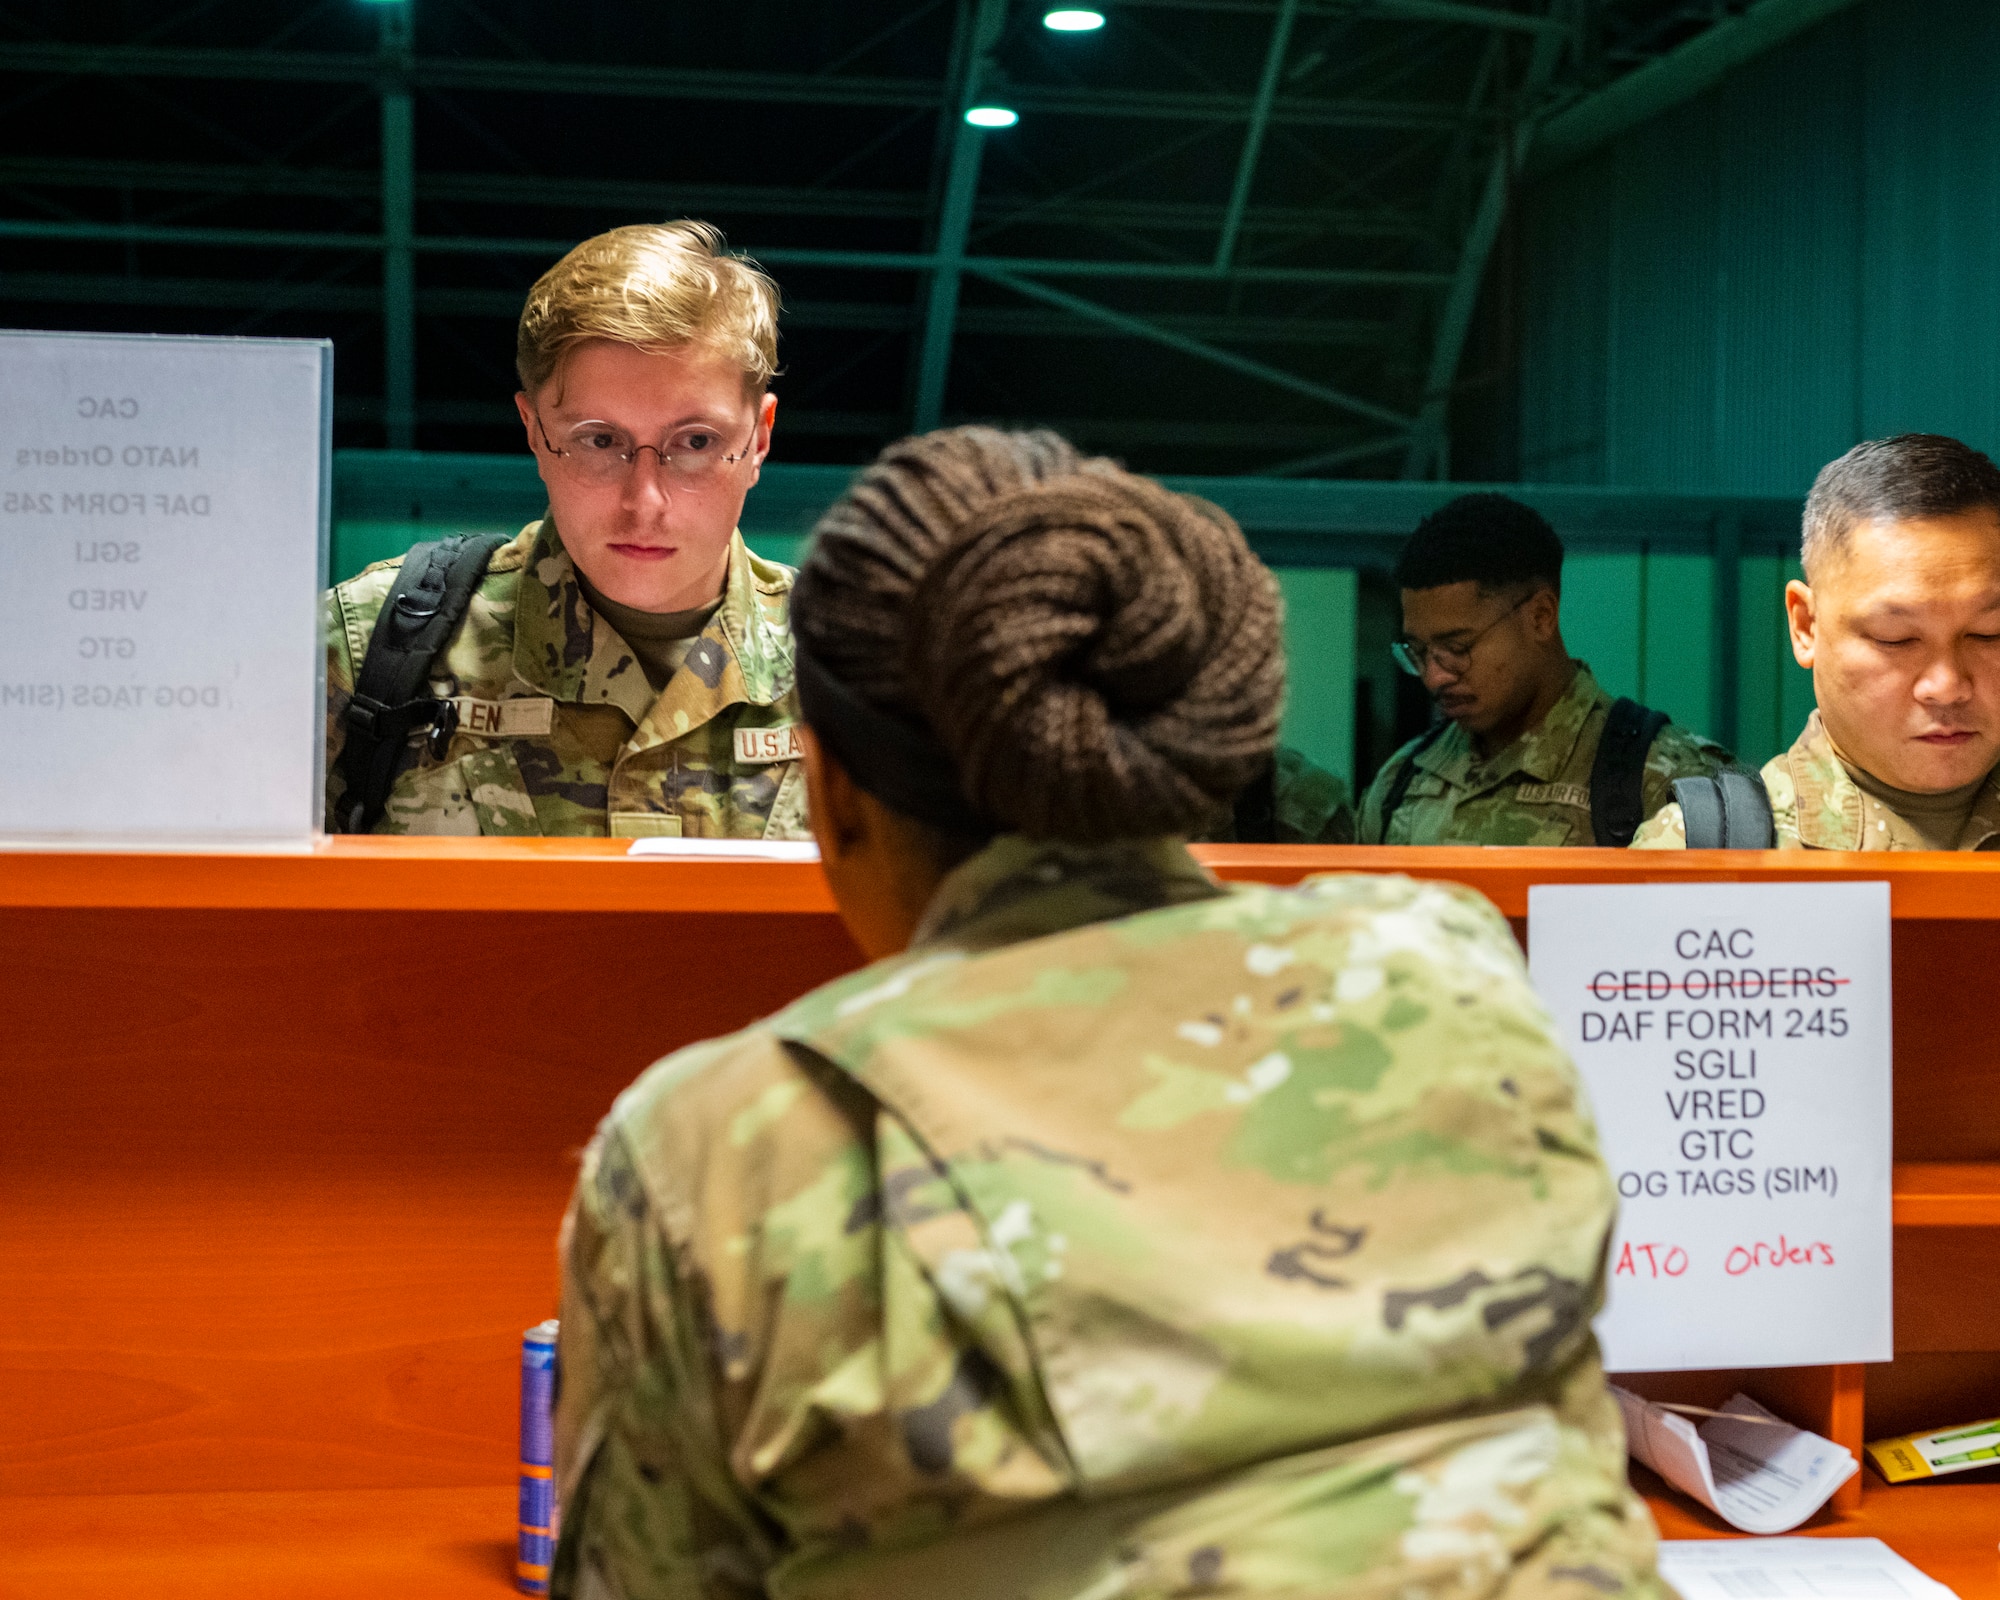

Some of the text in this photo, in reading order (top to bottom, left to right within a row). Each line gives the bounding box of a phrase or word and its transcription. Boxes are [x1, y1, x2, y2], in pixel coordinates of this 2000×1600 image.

[1675, 929, 1753, 960] CAC
[1591, 968, 1838, 1001] CED ORDERS
[1582, 1008, 1848, 1042] DAF FORM 245
[1675, 1049, 1755, 1080] SGLI
[1666, 1089, 1765, 1120] VRED
[1680, 1129, 1753, 1161] GTC
[1678, 1169, 1755, 1194] TAGS
[1765, 1167, 1837, 1197] (SIM)
